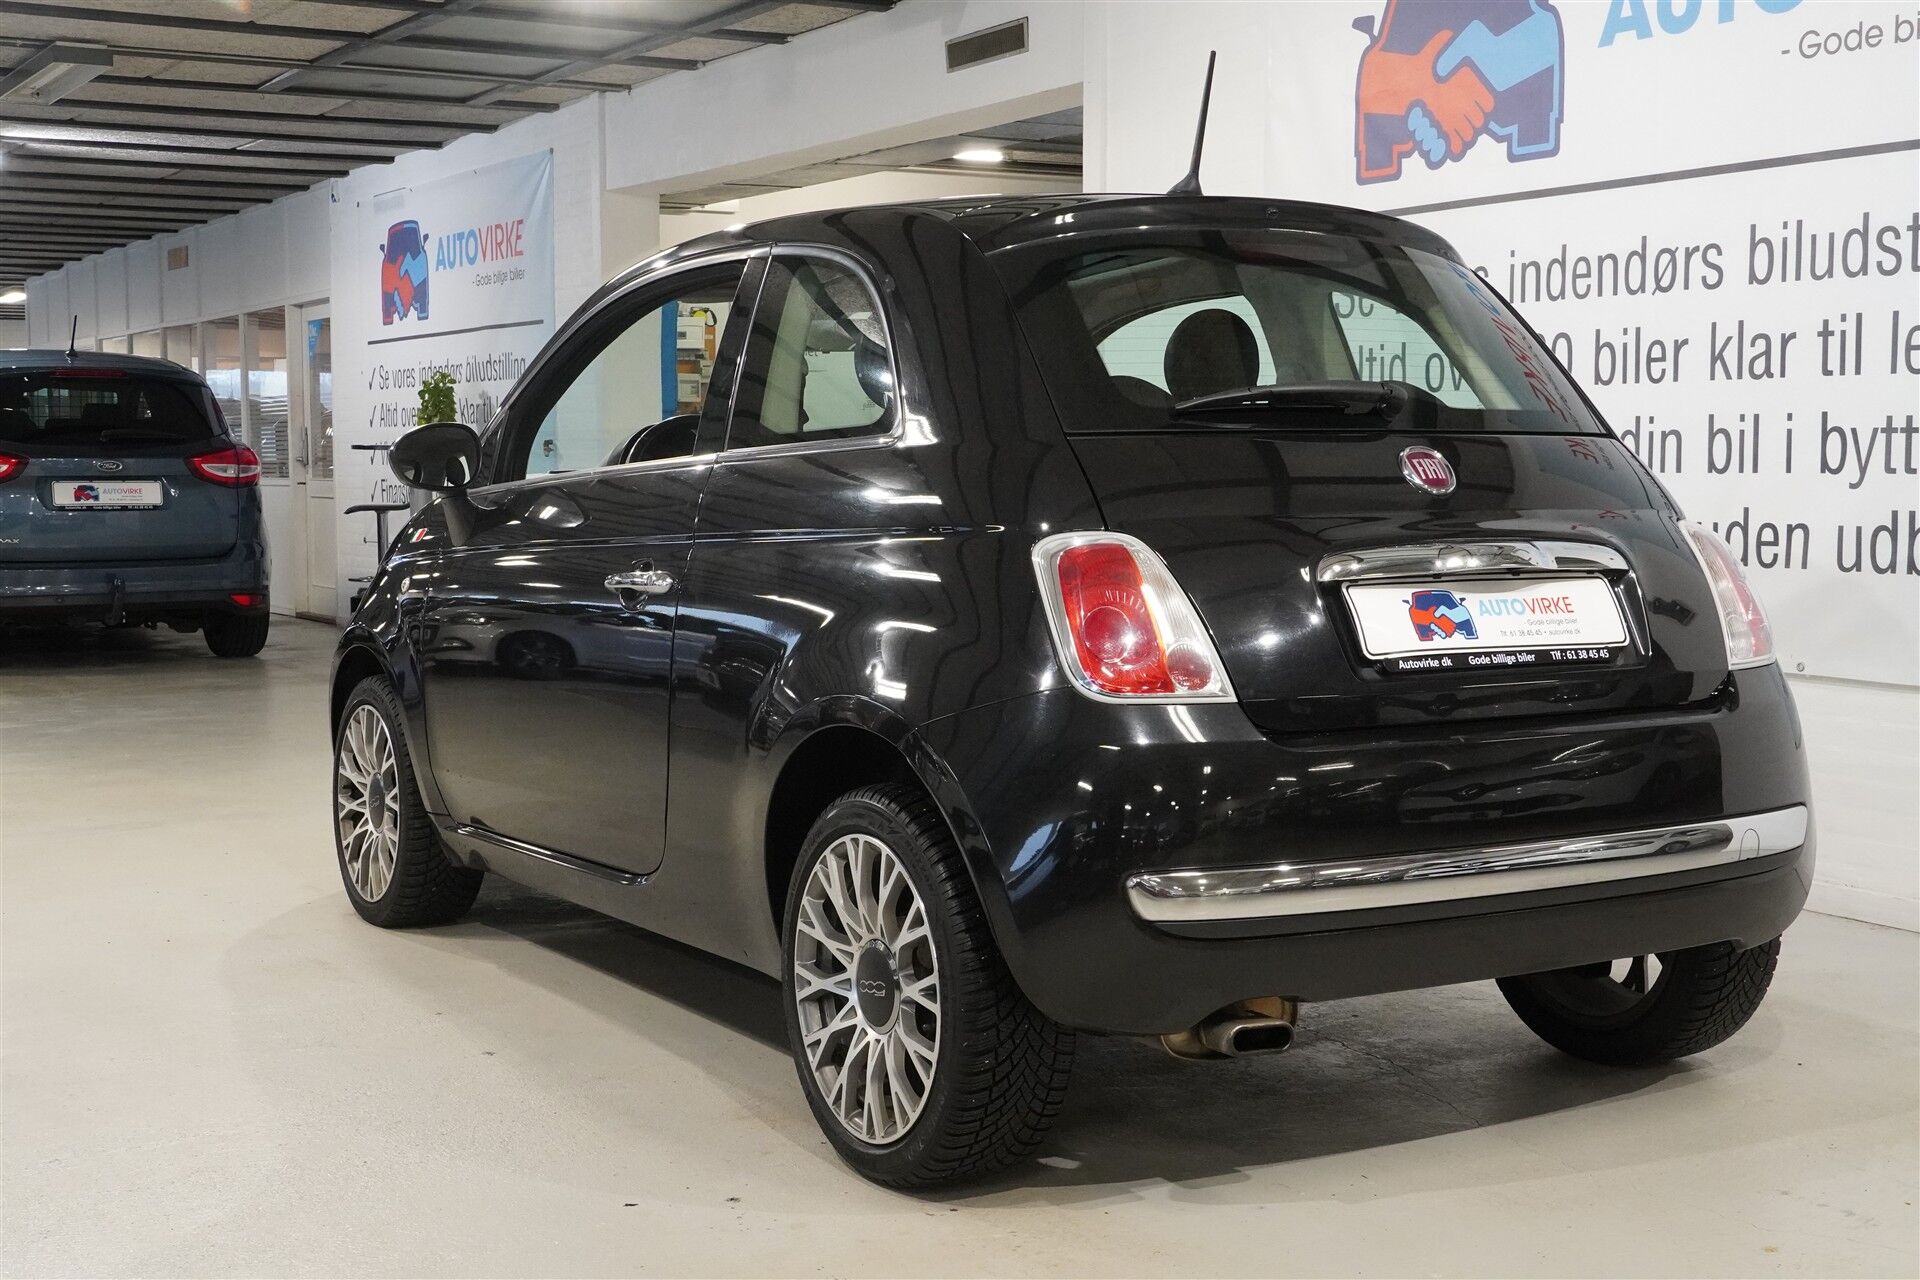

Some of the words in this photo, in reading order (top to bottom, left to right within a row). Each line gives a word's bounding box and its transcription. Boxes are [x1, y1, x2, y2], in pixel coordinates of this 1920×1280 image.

[1798, 21, 1884, 59] Gode
[435, 218, 524, 272] AUTOVIRKE
[1508, 235, 1724, 304] indendørs
[1748, 212, 1920, 286] biludst
[475, 273, 492, 287] Gode
[1358, 342, 1407, 382] ltid
[1594, 326, 1689, 386] biler
[1709, 319, 1797, 381] klar
[1816, 312, 1863, 377] til
[378, 364, 390, 390] Se
[392, 366, 416, 388] vores
[379, 402, 399, 428] Altid
[401, 406, 419, 428] ove
[458, 397, 480, 424] klar
[482, 396, 492, 424] til
[1707, 413, 1760, 475] bil
[1785, 412, 1793, 474] i
[1819, 411, 1920, 490] bytt
[1410, 458, 1447, 480] FIAT
[103, 487, 143, 495] AUTOVIRKE
[1696, 507, 1810, 570] den
[1479, 596, 1575, 617] AUTOVIRKE
[1399, 658, 1440, 669] Autovirke
[1441, 656, 1453, 667] dk
[1468, 654, 1491, 665] Gode
[1491, 653, 1517, 664] billige
[1516, 652, 1536, 662] biler
[1549, 650, 1562, 660] Tlf
[1566, 650, 1577, 660] 61
[1577, 649, 1588, 659] 38
[1588, 649, 1599, 659] 45
[1599, 648, 1610, 658] 45
